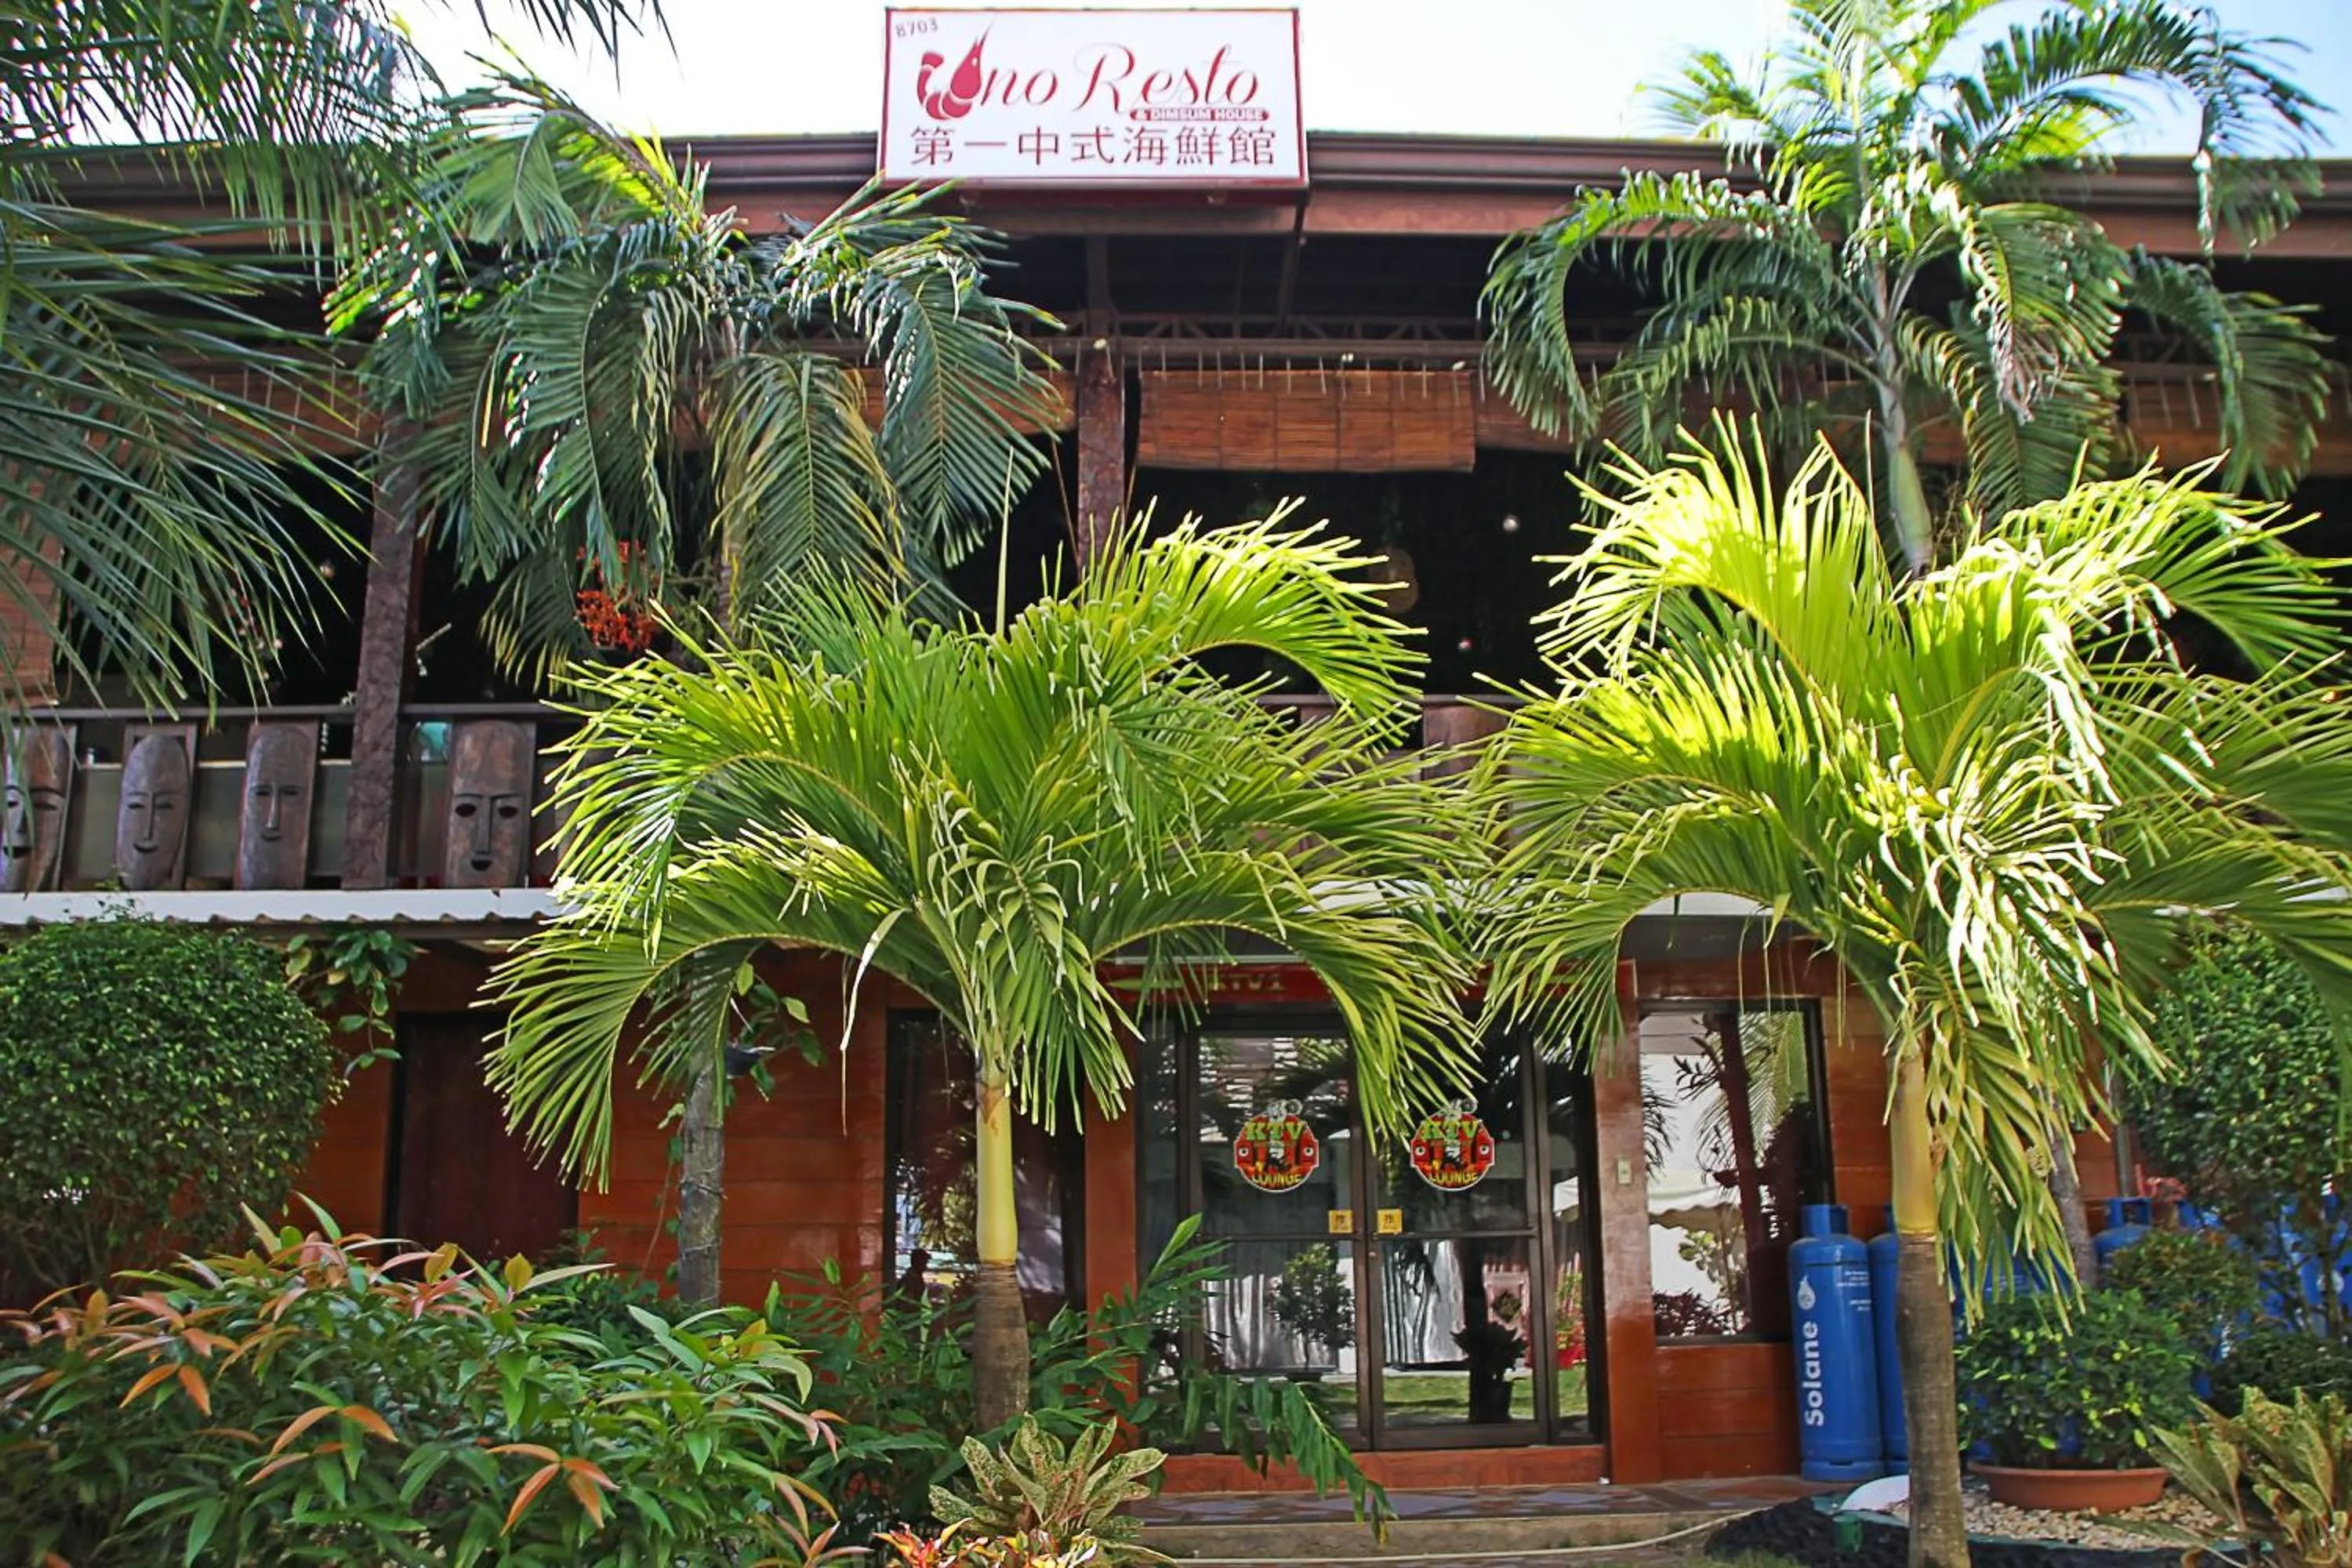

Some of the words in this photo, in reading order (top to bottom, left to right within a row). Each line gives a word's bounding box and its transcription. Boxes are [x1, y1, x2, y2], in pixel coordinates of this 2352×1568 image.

[895, 18, 938, 38] 8703
[1072, 42, 1259, 114] Resto
[1152, 107, 1210, 120] DIMSUM
[1217, 107, 1261, 120] HOUSE
[910, 125, 1276, 165] 第一中式海鮮館
[1244, 1121, 1305, 1142] KTV
[1421, 1119, 1482, 1140] KTV
[1252, 1172, 1302, 1186] LOUNGE
[1428, 1171, 1479, 1185] LOUNGE
[1802, 1320, 1824, 1427] Solane
